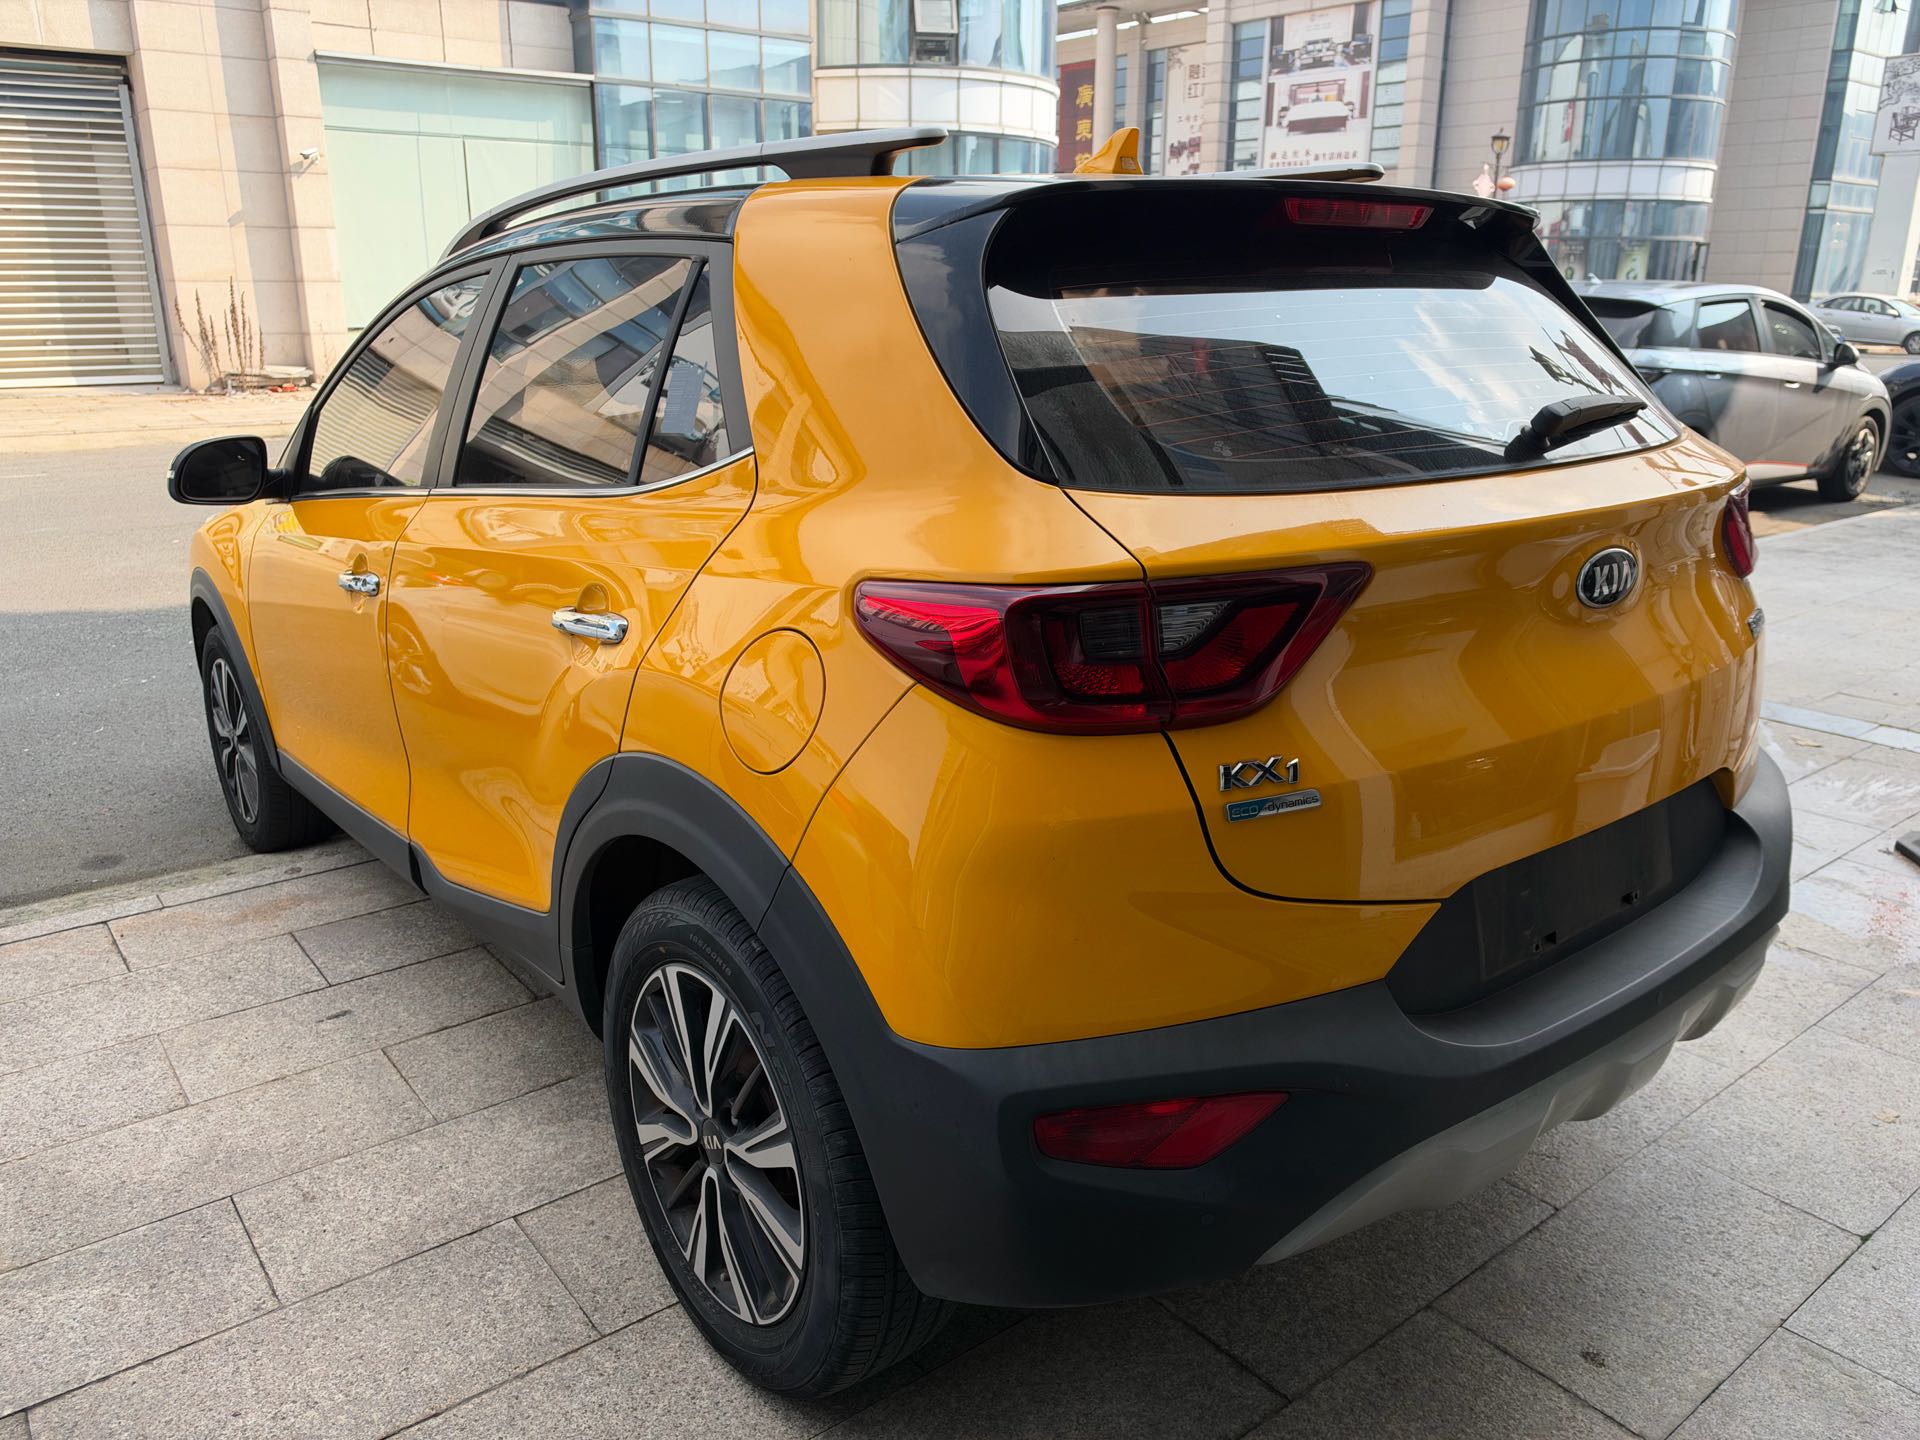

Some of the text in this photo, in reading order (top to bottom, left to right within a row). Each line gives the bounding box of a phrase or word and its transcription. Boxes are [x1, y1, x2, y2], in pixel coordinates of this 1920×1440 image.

[1592, 560, 1633, 598] KIA
[1219, 756, 1299, 791] KX1
[702, 1135, 722, 1150] KIA
